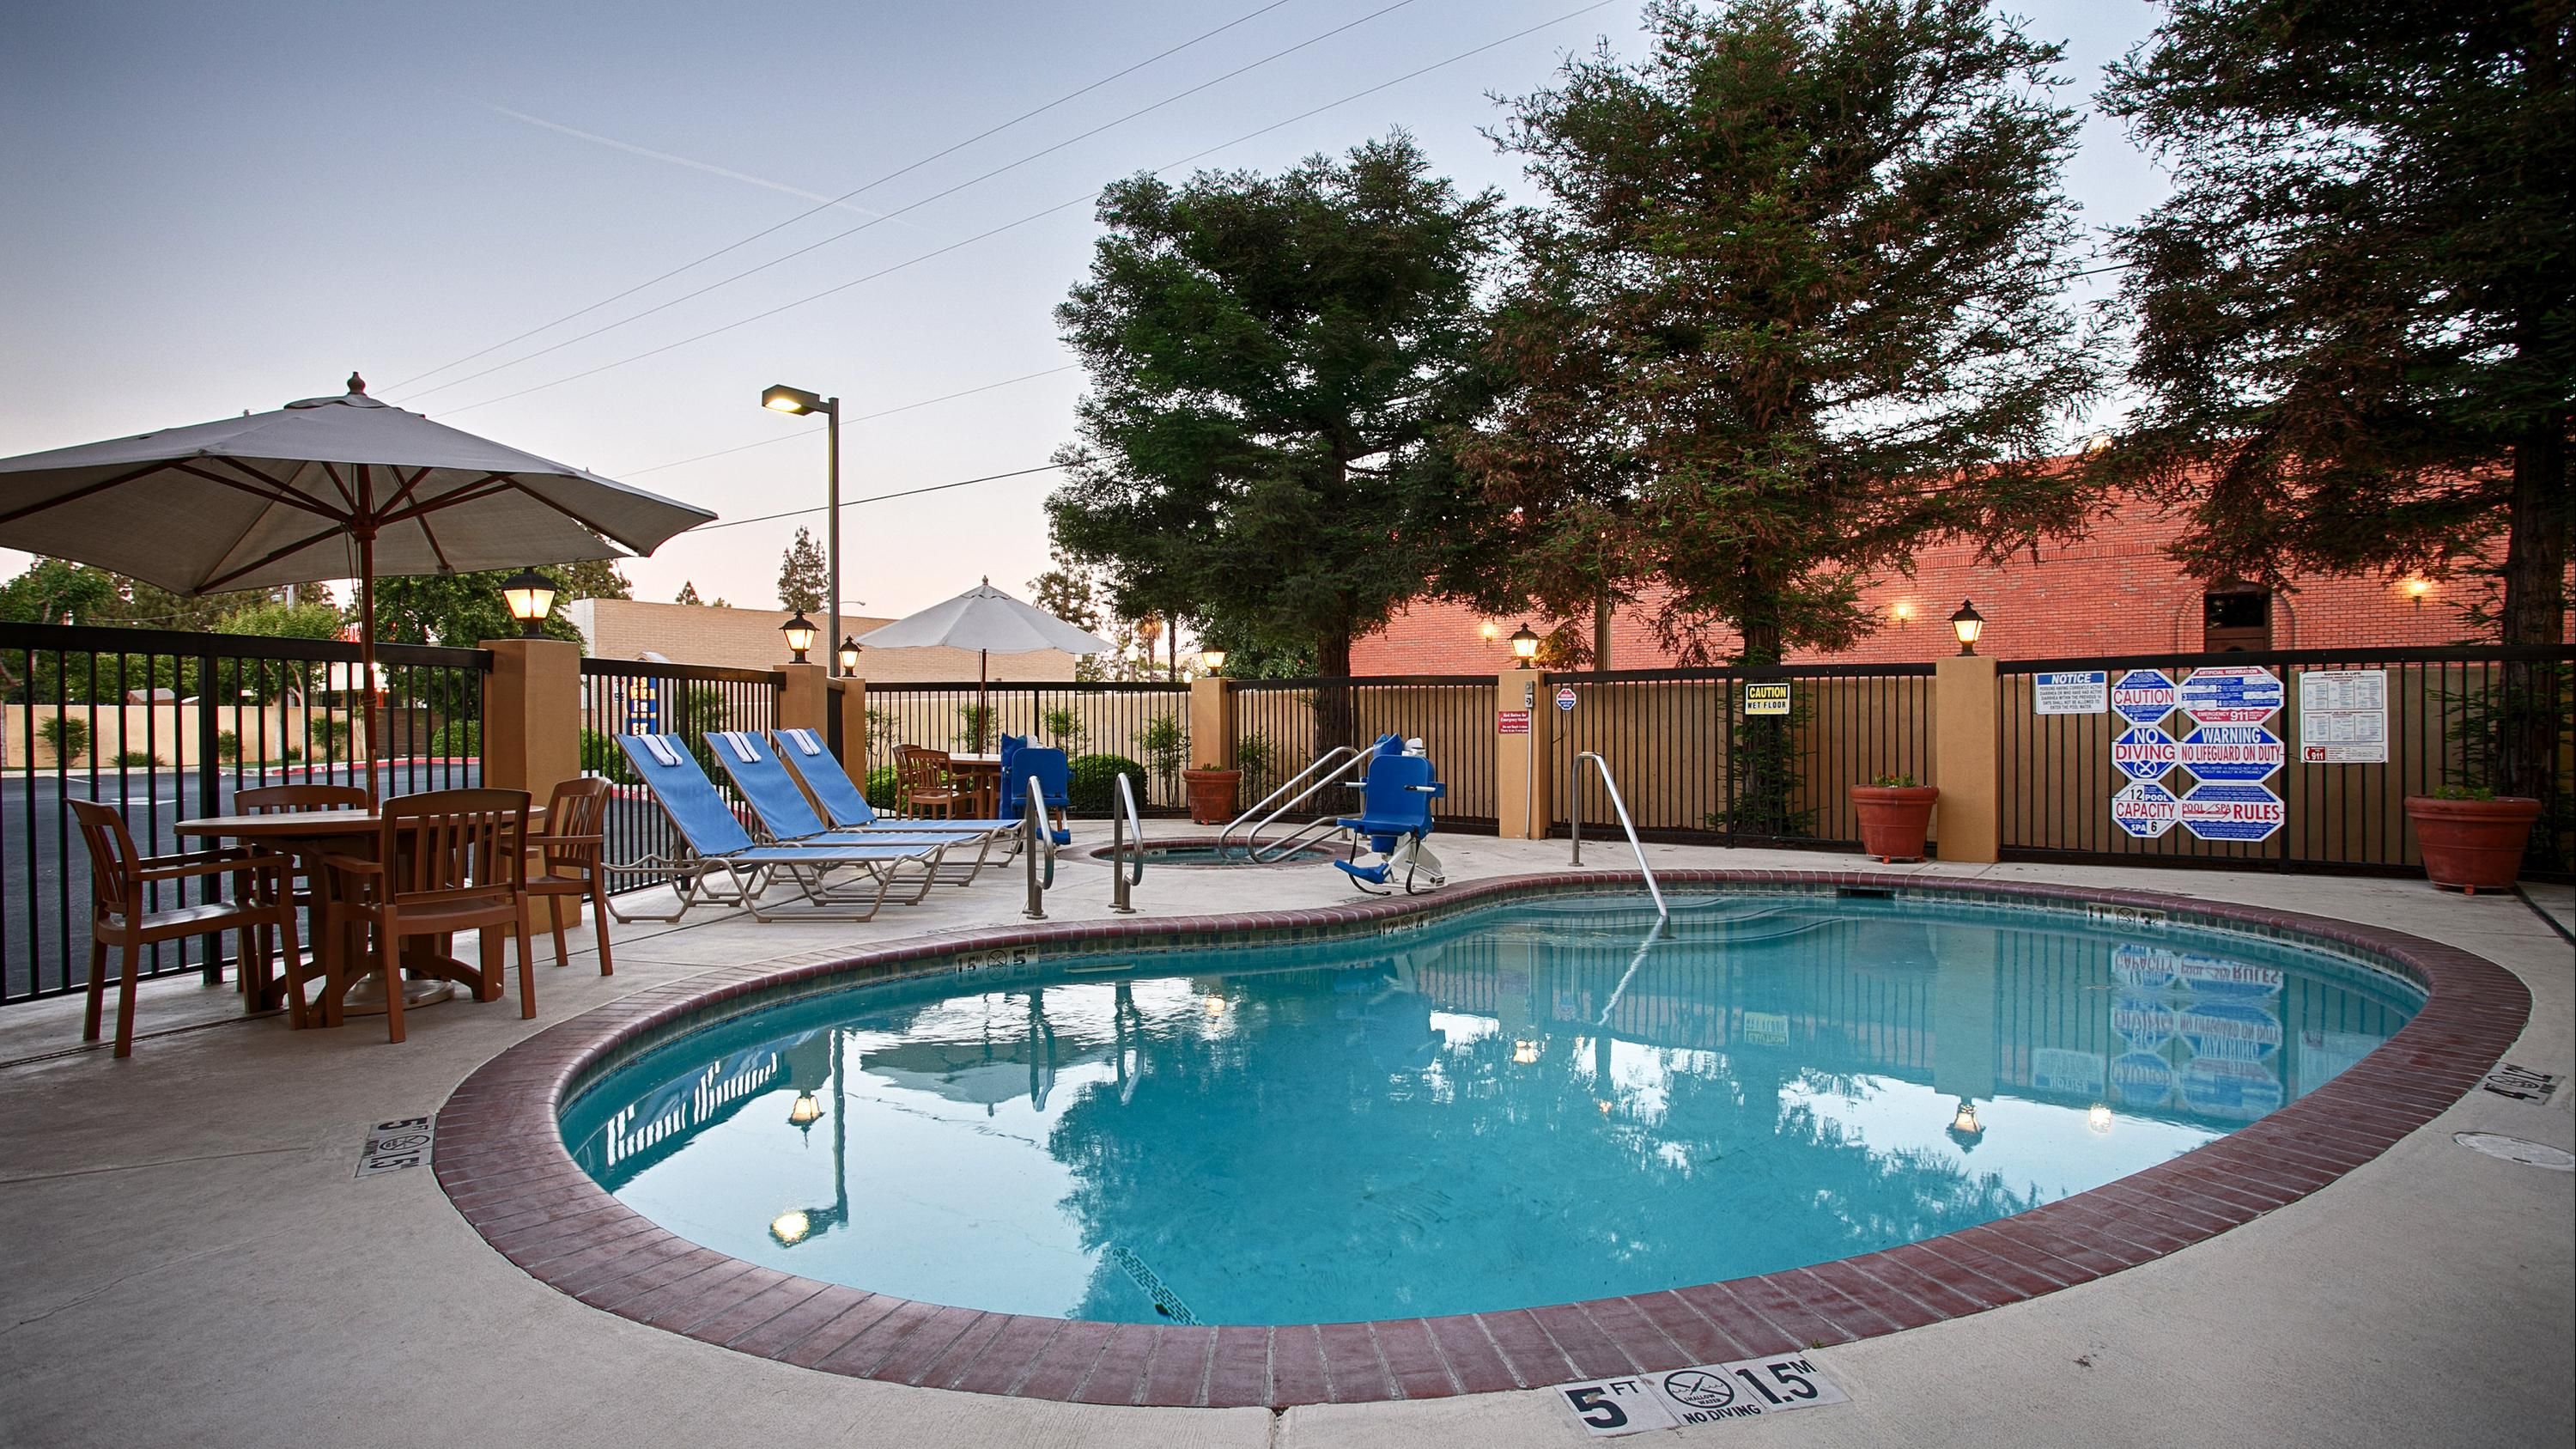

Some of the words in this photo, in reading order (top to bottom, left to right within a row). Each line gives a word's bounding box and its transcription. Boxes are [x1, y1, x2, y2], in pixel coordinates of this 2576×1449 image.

[2051, 673, 2092, 685] NOTICE
[1750, 687, 1786, 698] CAUTION
[2113, 689, 2174, 704] CAUTION
[2230, 711, 2249, 721] 911
[2134, 728, 2159, 744] NO
[2202, 728, 2262, 744] WARNING
[2116, 745, 2176, 760] DIVING
[2181, 746, 2193, 761] NO
[2196, 746, 2240, 761] LIFEGUARD
[2243, 746, 2256, 761] ON
[2258, 746, 2281, 761] DUTY
[2130, 789, 2143, 800] 12
[2116, 802, 2175, 818] CAPACITY
[2182, 803, 2204, 812] POOL
[2215, 803, 2232, 813] SPA
[2233, 804, 2280, 820] RULES
[2151, 821, 2157, 831] 6
[1013, 948, 1026, 965] 5
[378, 1117, 428, 1130] 5
[1735, 1362, 1819, 1404] 1.5
[1788, 1360, 1818, 1374] M
[1564, 1386, 1628, 1429] 5
[1609, 1380, 1639, 1396] FT
[1682, 1411, 1708, 1424] NO
[1705, 1403, 1762, 1421] DIVING
